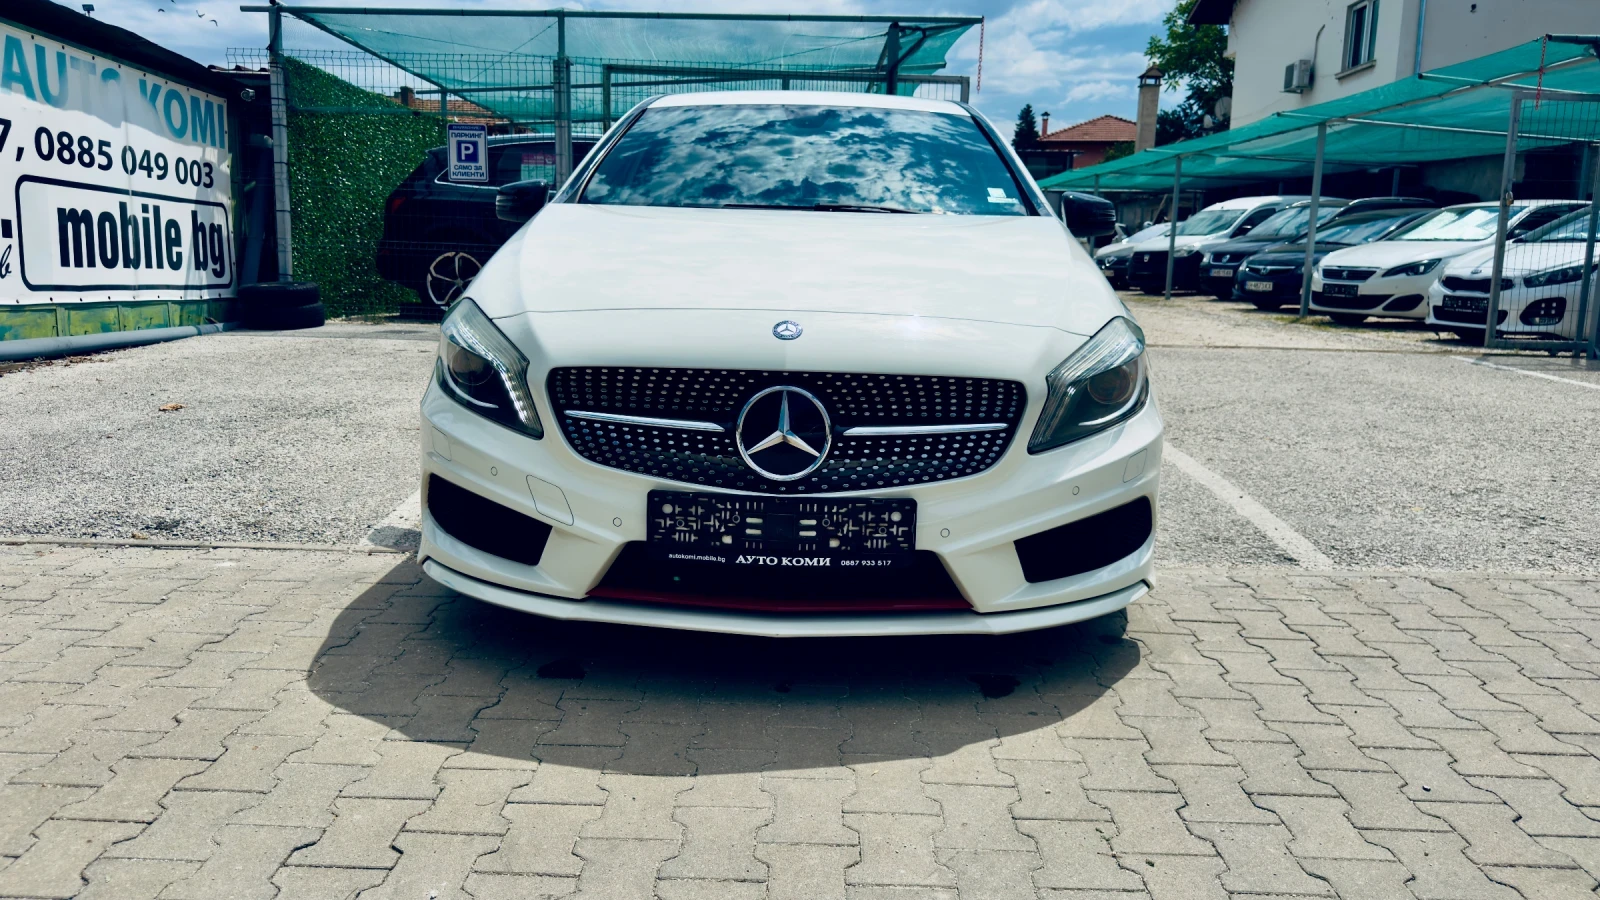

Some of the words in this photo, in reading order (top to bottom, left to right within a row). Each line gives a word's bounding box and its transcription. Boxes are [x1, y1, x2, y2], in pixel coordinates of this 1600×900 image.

[139, 78, 226, 149] KOMI
[34, 126, 114, 172] 0885
[121, 145, 168, 181] 049
[175, 157, 214, 188] 003
[461, 143, 474, 160] P
[57, 201, 183, 271] mobile
[191, 210, 226, 279] bg
[668, 553, 726, 563] autokomi.mobile.bg
[735, 554, 778, 566] АУТО
[780, 556, 831, 566] КОМИ
